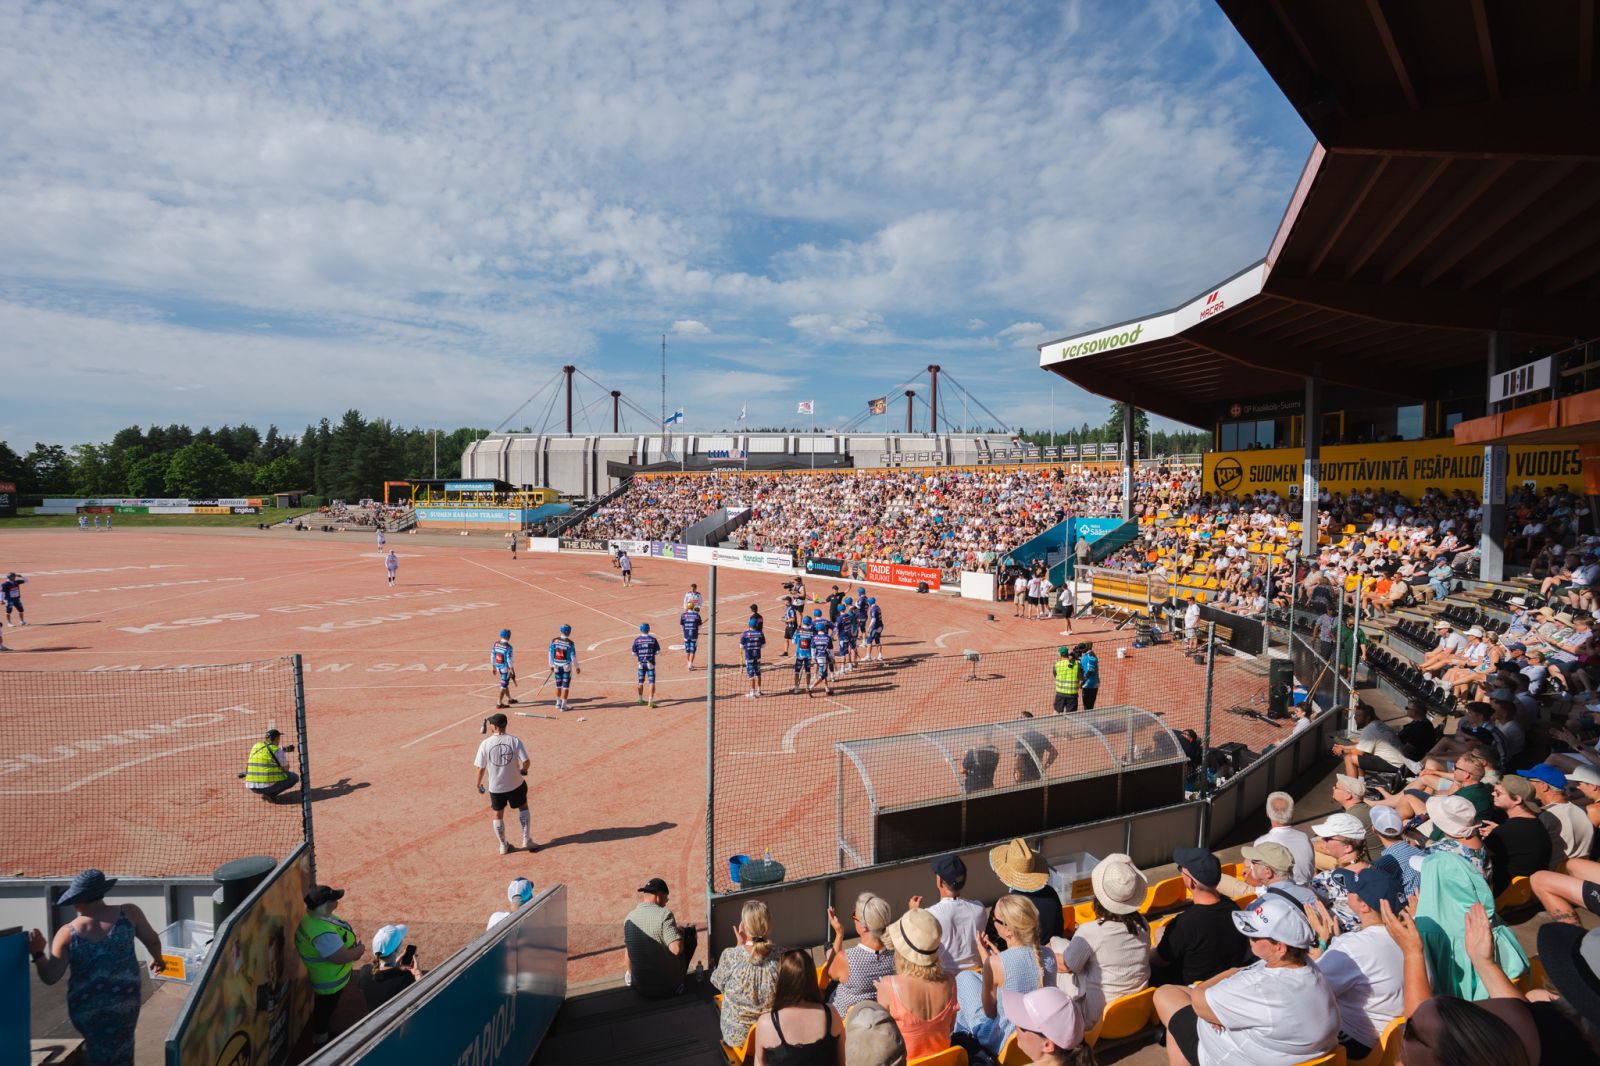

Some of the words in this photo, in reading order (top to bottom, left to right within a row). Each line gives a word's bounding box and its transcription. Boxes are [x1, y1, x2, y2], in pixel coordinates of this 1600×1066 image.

[1061, 323, 1144, 360] versowood
[1071, 463, 1082, 474] C1
[1216, 467, 1239, 484] KPL
[1250, 463, 1297, 482] SUOMEN
[1302, 457, 1408, 482] HDYTTÄVINTÄ
[563, 541, 579, 549] THE
[580, 541, 603, 549] BANK
[869, 564, 891, 575] TAIDE
[869, 573, 890, 583] RUUKKI
[116, 611, 261, 634] KSS
